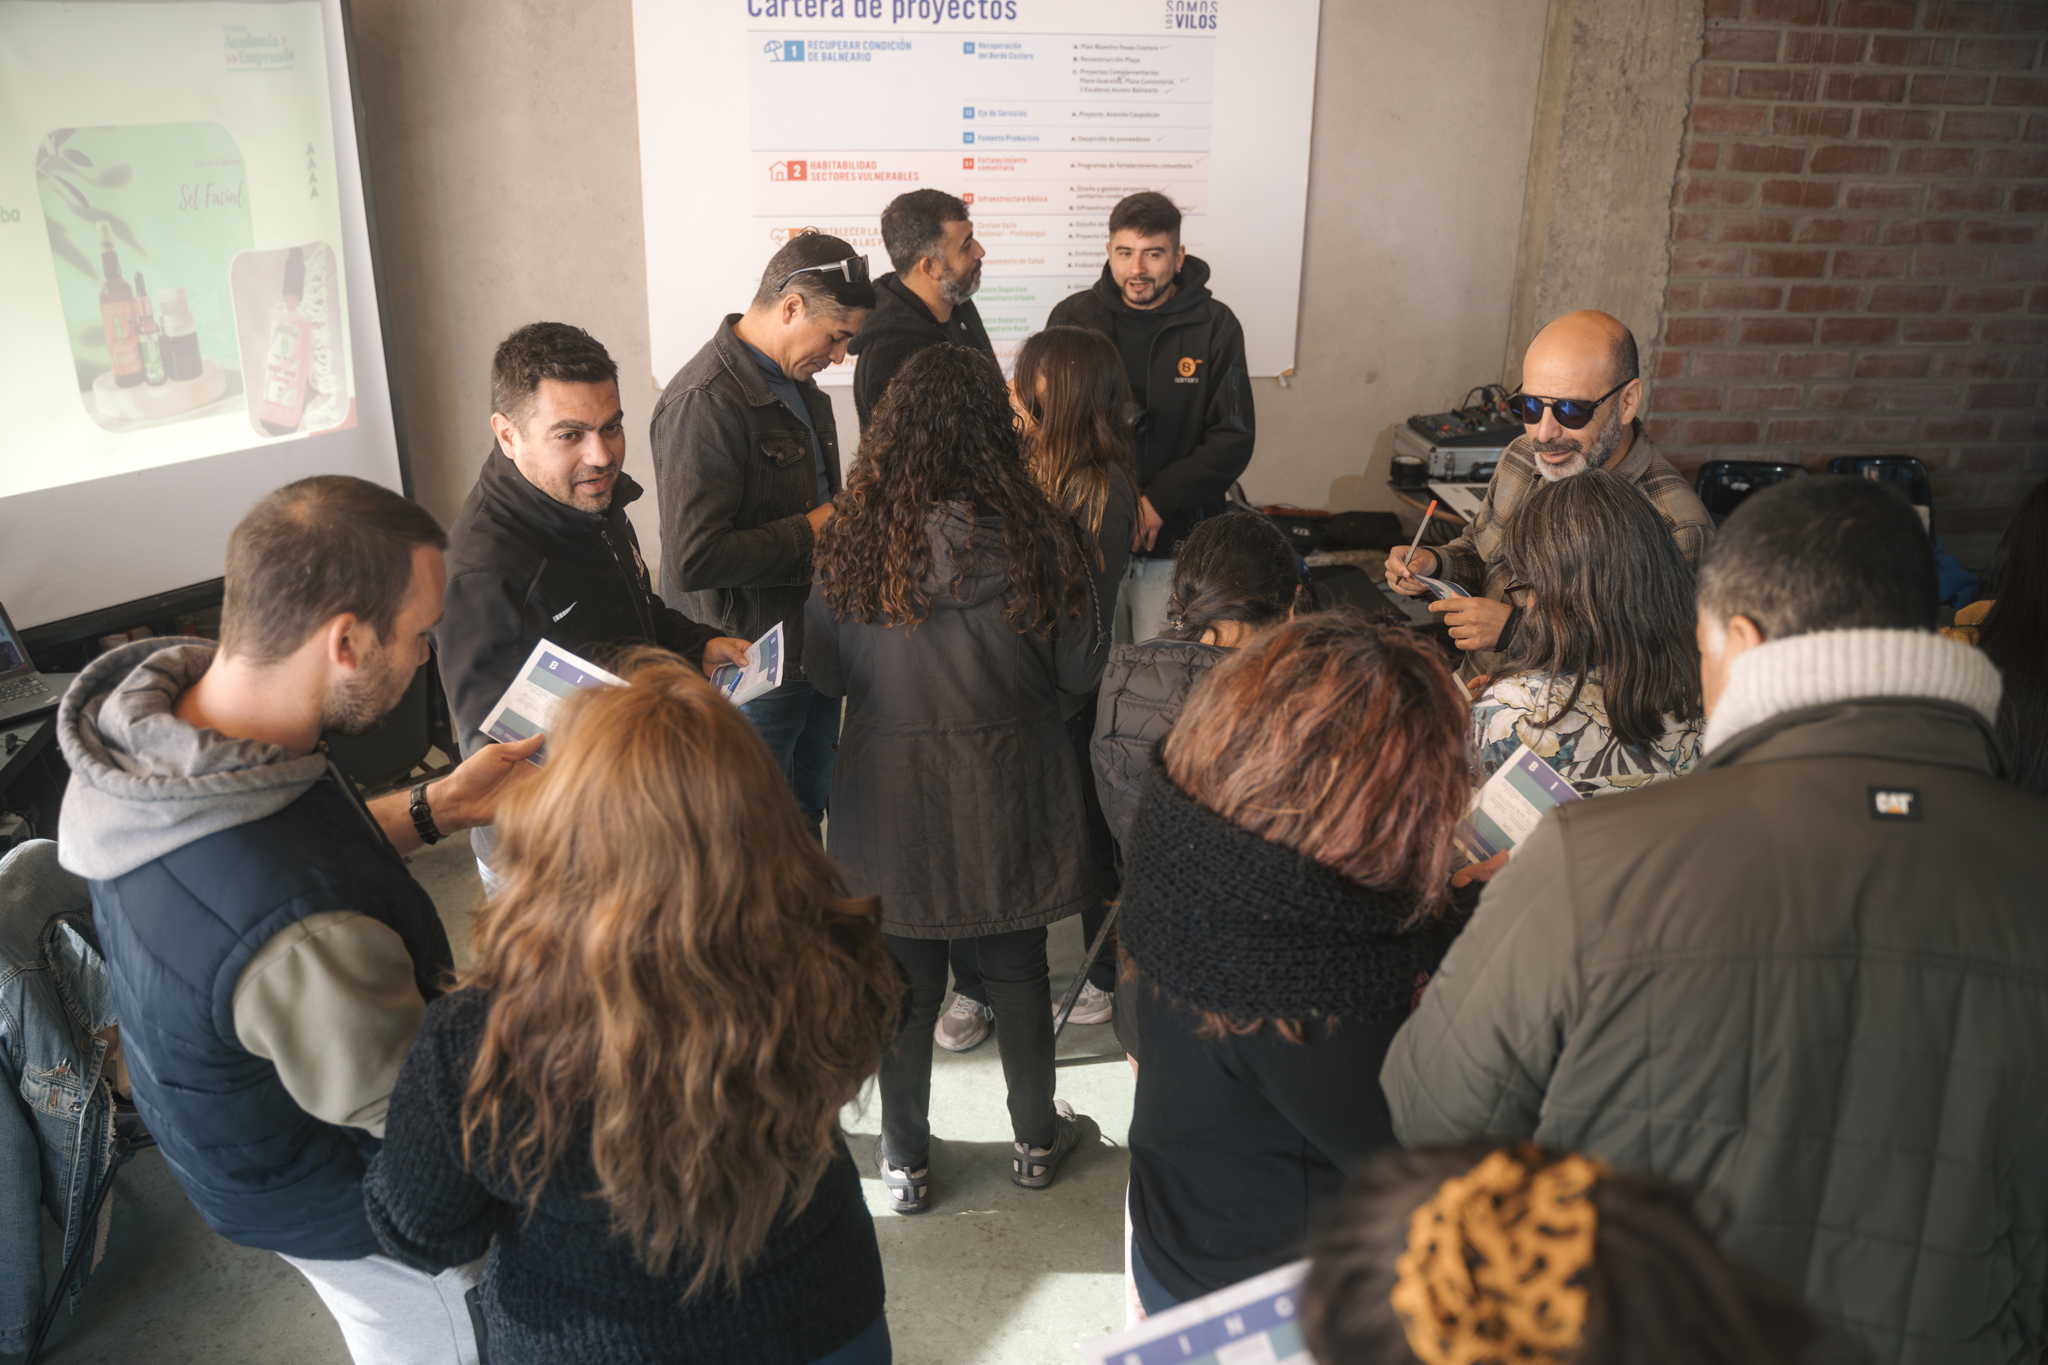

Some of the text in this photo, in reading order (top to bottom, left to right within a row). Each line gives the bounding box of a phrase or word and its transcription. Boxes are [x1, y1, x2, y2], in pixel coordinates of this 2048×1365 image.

[748, 0, 1017, 24] Cartera de proyectos
[1166, 0, 1218, 13] SOMOS
[1175, 14, 1217, 29] VILOS
[225, 33, 279, 49] Academia
[808, 39, 912, 51] RECUPERAR CONDICIÓN
[978, 42, 1022, 50] Recuperación
[239, 46, 295, 67] Emprende
[791, 44, 798, 59] 1
[808, 52, 871, 62] DE BALNEARIO
[810, 161, 877, 170] HABITABILIDAD
[793, 165, 801, 178] 2
[810, 171, 919, 181] SECTORES VULNERABLES
[179, 179, 245, 211] Set Facial
[977, 195, 1026, 203] Infraestructura
[819, 227, 879, 236] ORTALECER LA
[860, 238, 876, 247] LAS
[548, 660, 559, 671] B
[1528, 761, 1539, 772] B
